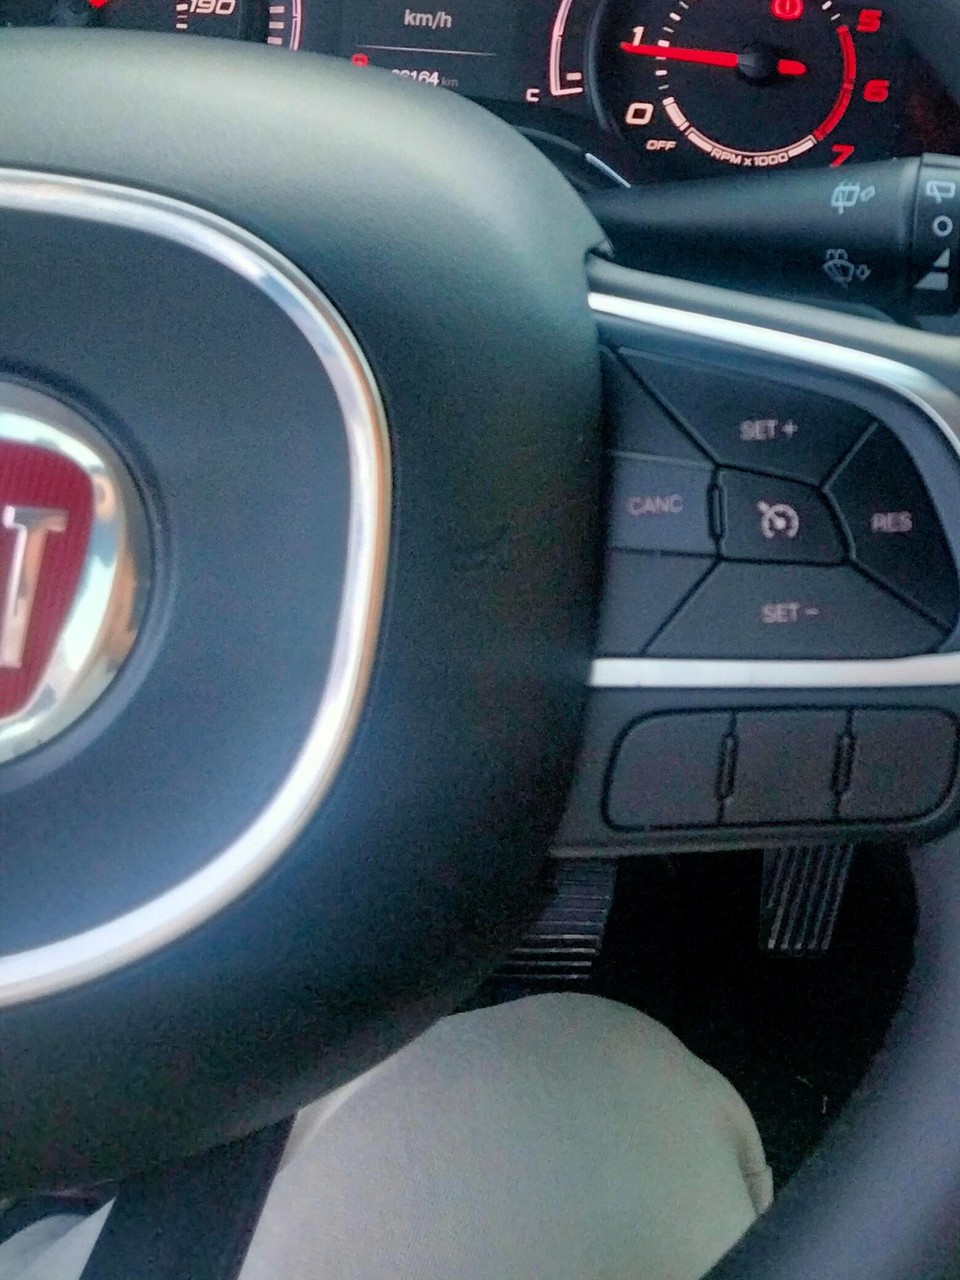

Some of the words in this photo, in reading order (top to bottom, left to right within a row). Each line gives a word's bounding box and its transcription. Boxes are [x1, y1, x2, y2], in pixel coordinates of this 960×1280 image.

[404, 9, 452, 30] km/h
[857, 9, 883, 33] 5
[631, 26, 645, 46] 1
[863, 79, 889, 102] 6
[625, 102, 653, 125] 0
[646, 140, 677, 151] OFF
[711, 147, 742, 165] RPM
[829, 145, 854, 167] 7
